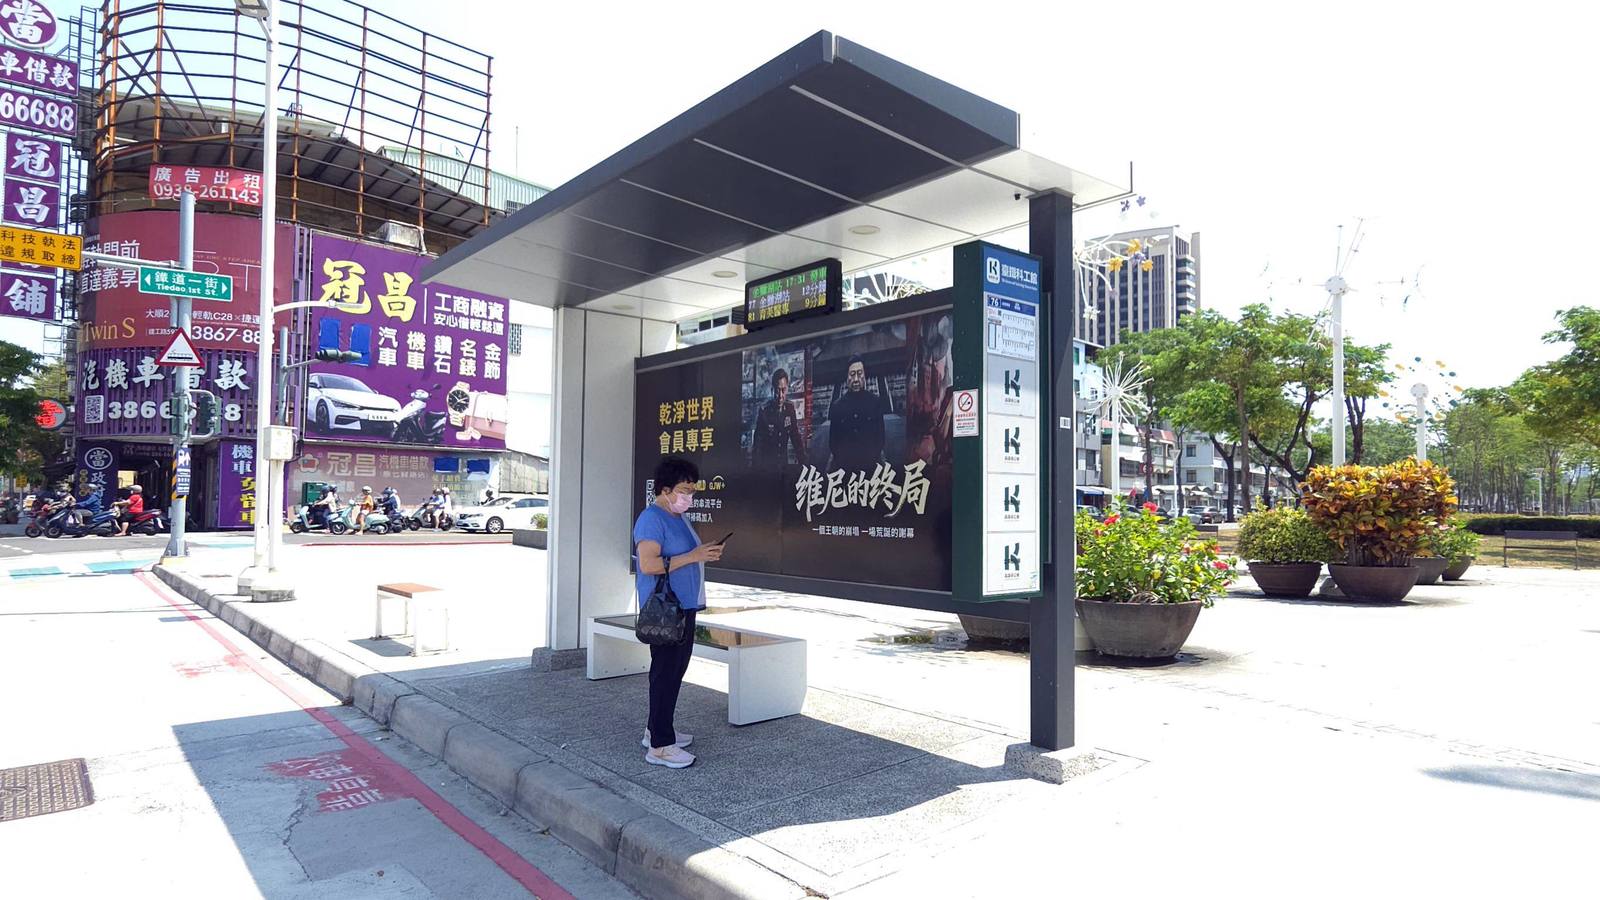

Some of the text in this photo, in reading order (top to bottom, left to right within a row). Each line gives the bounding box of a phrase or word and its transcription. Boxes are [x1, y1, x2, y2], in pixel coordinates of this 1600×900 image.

[0, 92, 74, 131] 66688
[154, 166, 260, 189] 廣告出租
[0, 230, 76, 250] 科技執法
[5, 138, 56, 315] 冠昌舖
[0, 245, 76, 265] 違規取締
[155, 271, 218, 289] 鐵道一街
[156, 283, 186, 292] Tiedao
[188, 286, 201, 294] 1st
[319, 258, 416, 322] 冠昌
[434, 292, 504, 321] 工商融資
[991, 297, 999, 307] 76
[82, 317, 136, 343] Twin S
[192, 325, 275, 344] 3867-88
[378, 326, 398, 367] 汽車
[406, 331, 427, 370] 機車
[434, 335, 452, 374] 鑽石
[459, 339, 477, 377] 名錶
[484, 343, 501, 380] 金飾
[108, 400, 241, 421] 38668
[659, 396, 714, 425] 乾淨世界
[659, 426, 714, 454] 會員專享
[89, 449, 108, 467] 當
[232, 444, 254, 475] 機車
[327, 452, 376, 477] 冠昌
[795, 459, 931, 522] 维尼的终局
[812, 525, 915, 538] 一個王朝的崩塌 一場荒誕的謝幕
